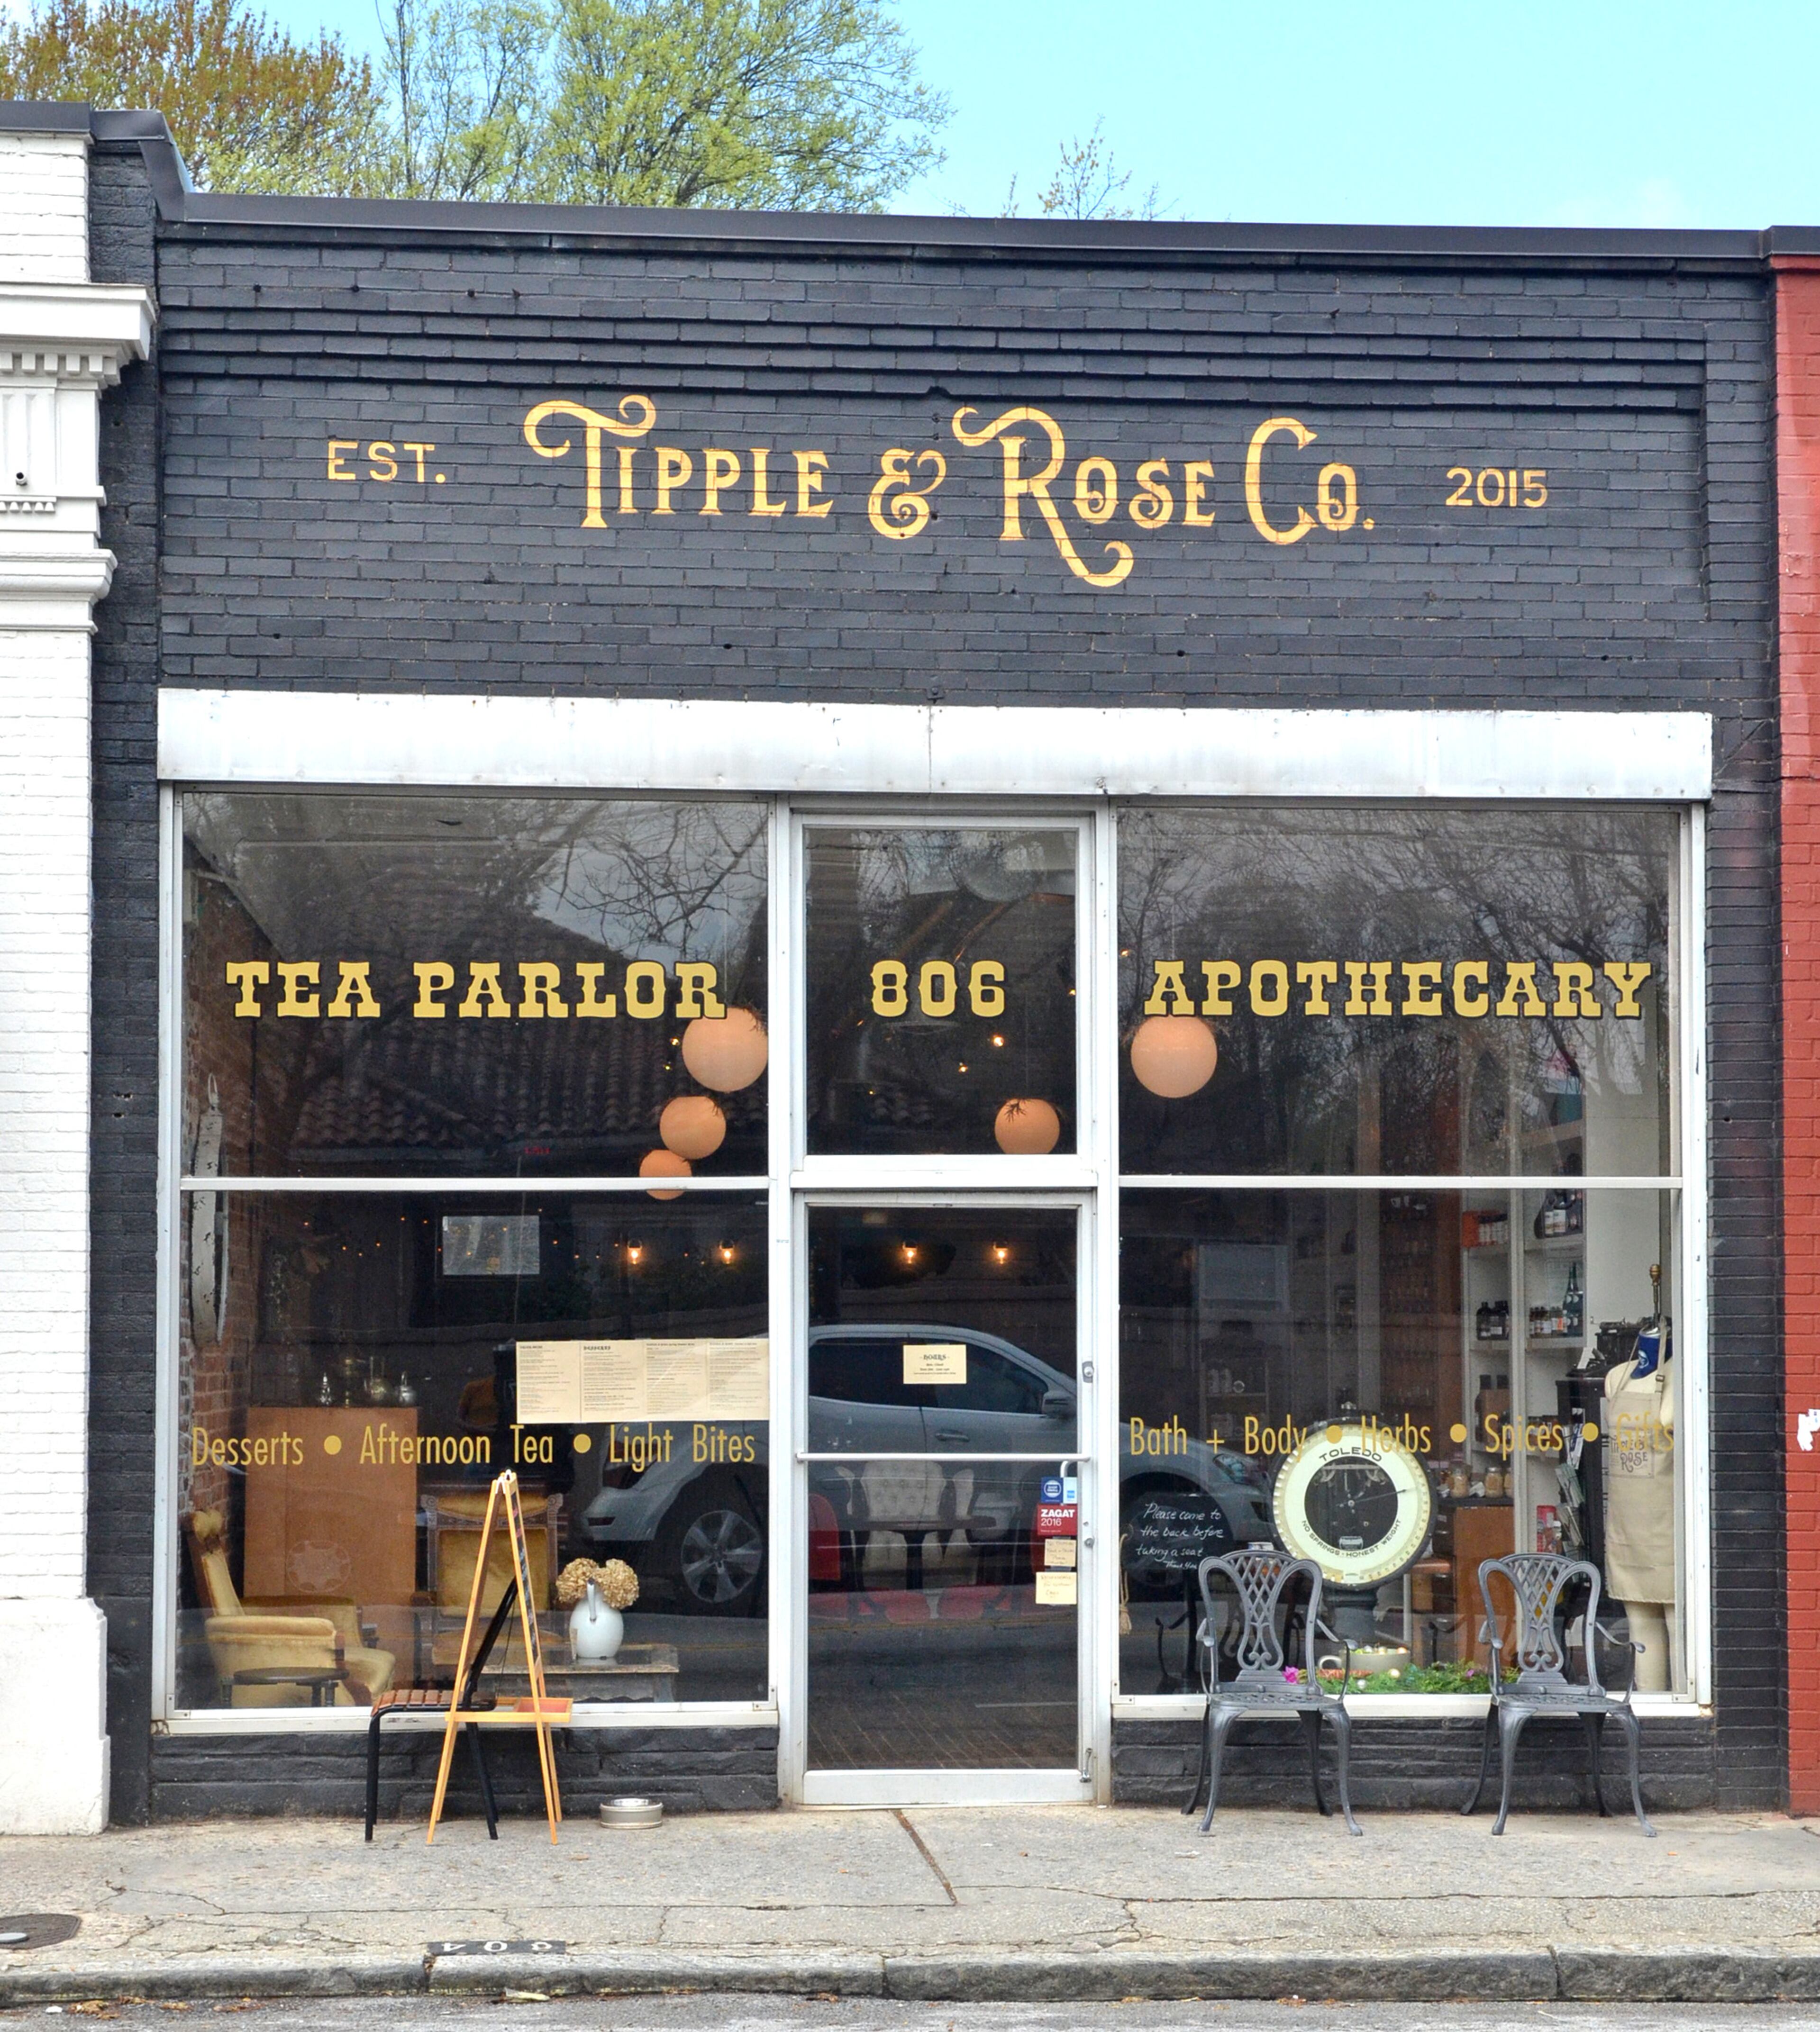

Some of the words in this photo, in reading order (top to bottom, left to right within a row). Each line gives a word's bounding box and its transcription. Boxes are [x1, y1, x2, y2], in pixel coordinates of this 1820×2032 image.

[328, 440, 446, 483] EST.
[524, 395, 833, 527] TIPPLE
[868, 448, 946, 539] &
[952, 407, 1215, 587] ROSE
[1245, 417, 1374, 544] CO.
[1447, 467, 1547, 508] 2015
[226, 962, 381, 1018] TEA
[413, 961, 727, 1019] PARLOR
[870, 960, 1005, 1017] 806
[1144, 960, 1652, 1019] APOTHECARY
[192, 1426, 304, 1466] Desserts
[359, 1423, 491, 1465] Afternoon
[510, 1424, 553, 1463] Tea
[610, 1423, 673, 1472] Light
[692, 1424, 755, 1463] Bites
[1130, 1415, 1187, 1455] Bath
[1244, 1414, 1307, 1462] Body
[1361, 1413, 1431, 1453] Herbs
[1484, 1414, 1563, 1460] Spices
[1616, 1410, 1674, 1451] Gifts
[1319, 1447, 1382, 1462] TOLEDO
[1620, 1451, 1648, 1473] ROSE
[1040, 1509, 1075, 1518] ZAGAT
[1040, 1517, 1062, 1526] 2016
[1143, 1502, 1176, 1520] Please
[1179, 1511, 1205, 1521] come
[1210, 1509, 1221, 1520] to
[1140, 1525, 1159, 1537] the
[1162, 1527, 1190, 1537] back
[1192, 1524, 1224, 1540] before
[1302, 1520, 1310, 1533] NO
[1309, 1533, 1341, 1556] SPRINGS
[1346, 1545, 1380, 1558] HONEST
[1381, 1519, 1401, 1545] WEIGHT
[1136, 1543, 1168, 1562] taking
[1171, 1549, 1178, 1557] a
